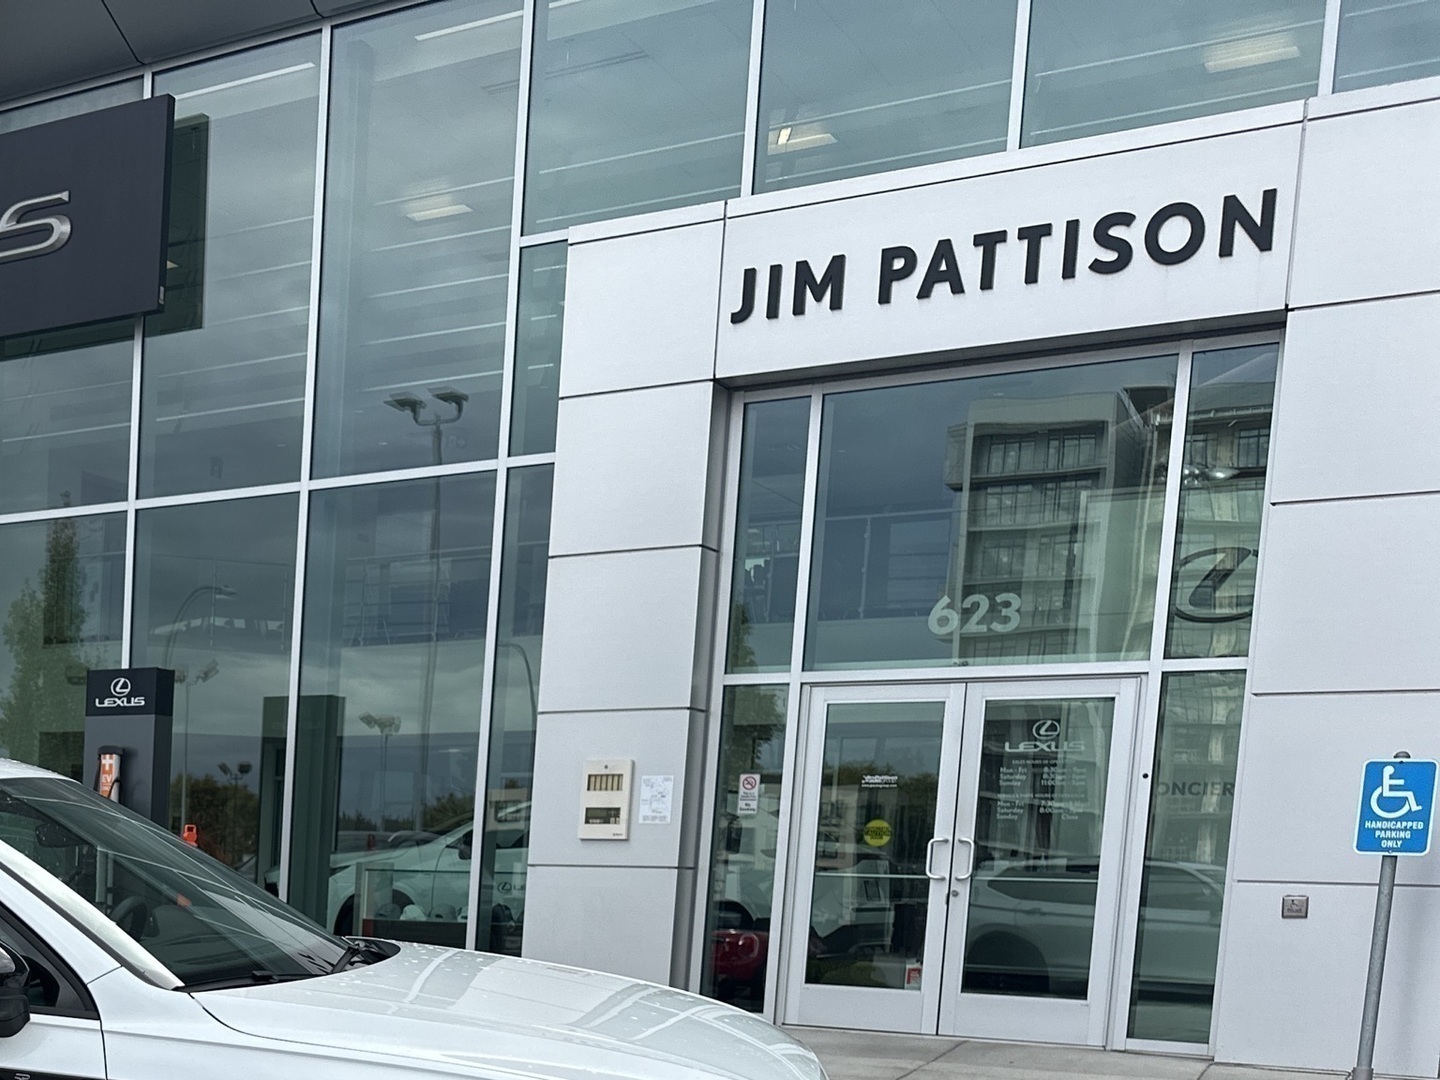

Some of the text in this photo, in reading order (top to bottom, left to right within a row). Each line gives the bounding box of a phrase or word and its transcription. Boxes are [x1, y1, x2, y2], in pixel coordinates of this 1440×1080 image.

[731, 188, 1277, 324] JIM PATTISON
[928, 593, 1021, 635] 623
[95, 697, 145, 707] LEXUS
[1005, 741, 1085, 752] LEXUS
[1365, 820, 1424, 830] HANDICAPPED
[1375, 830, 1411, 839] PARKING
[1381, 840, 1403, 848] ONLY
